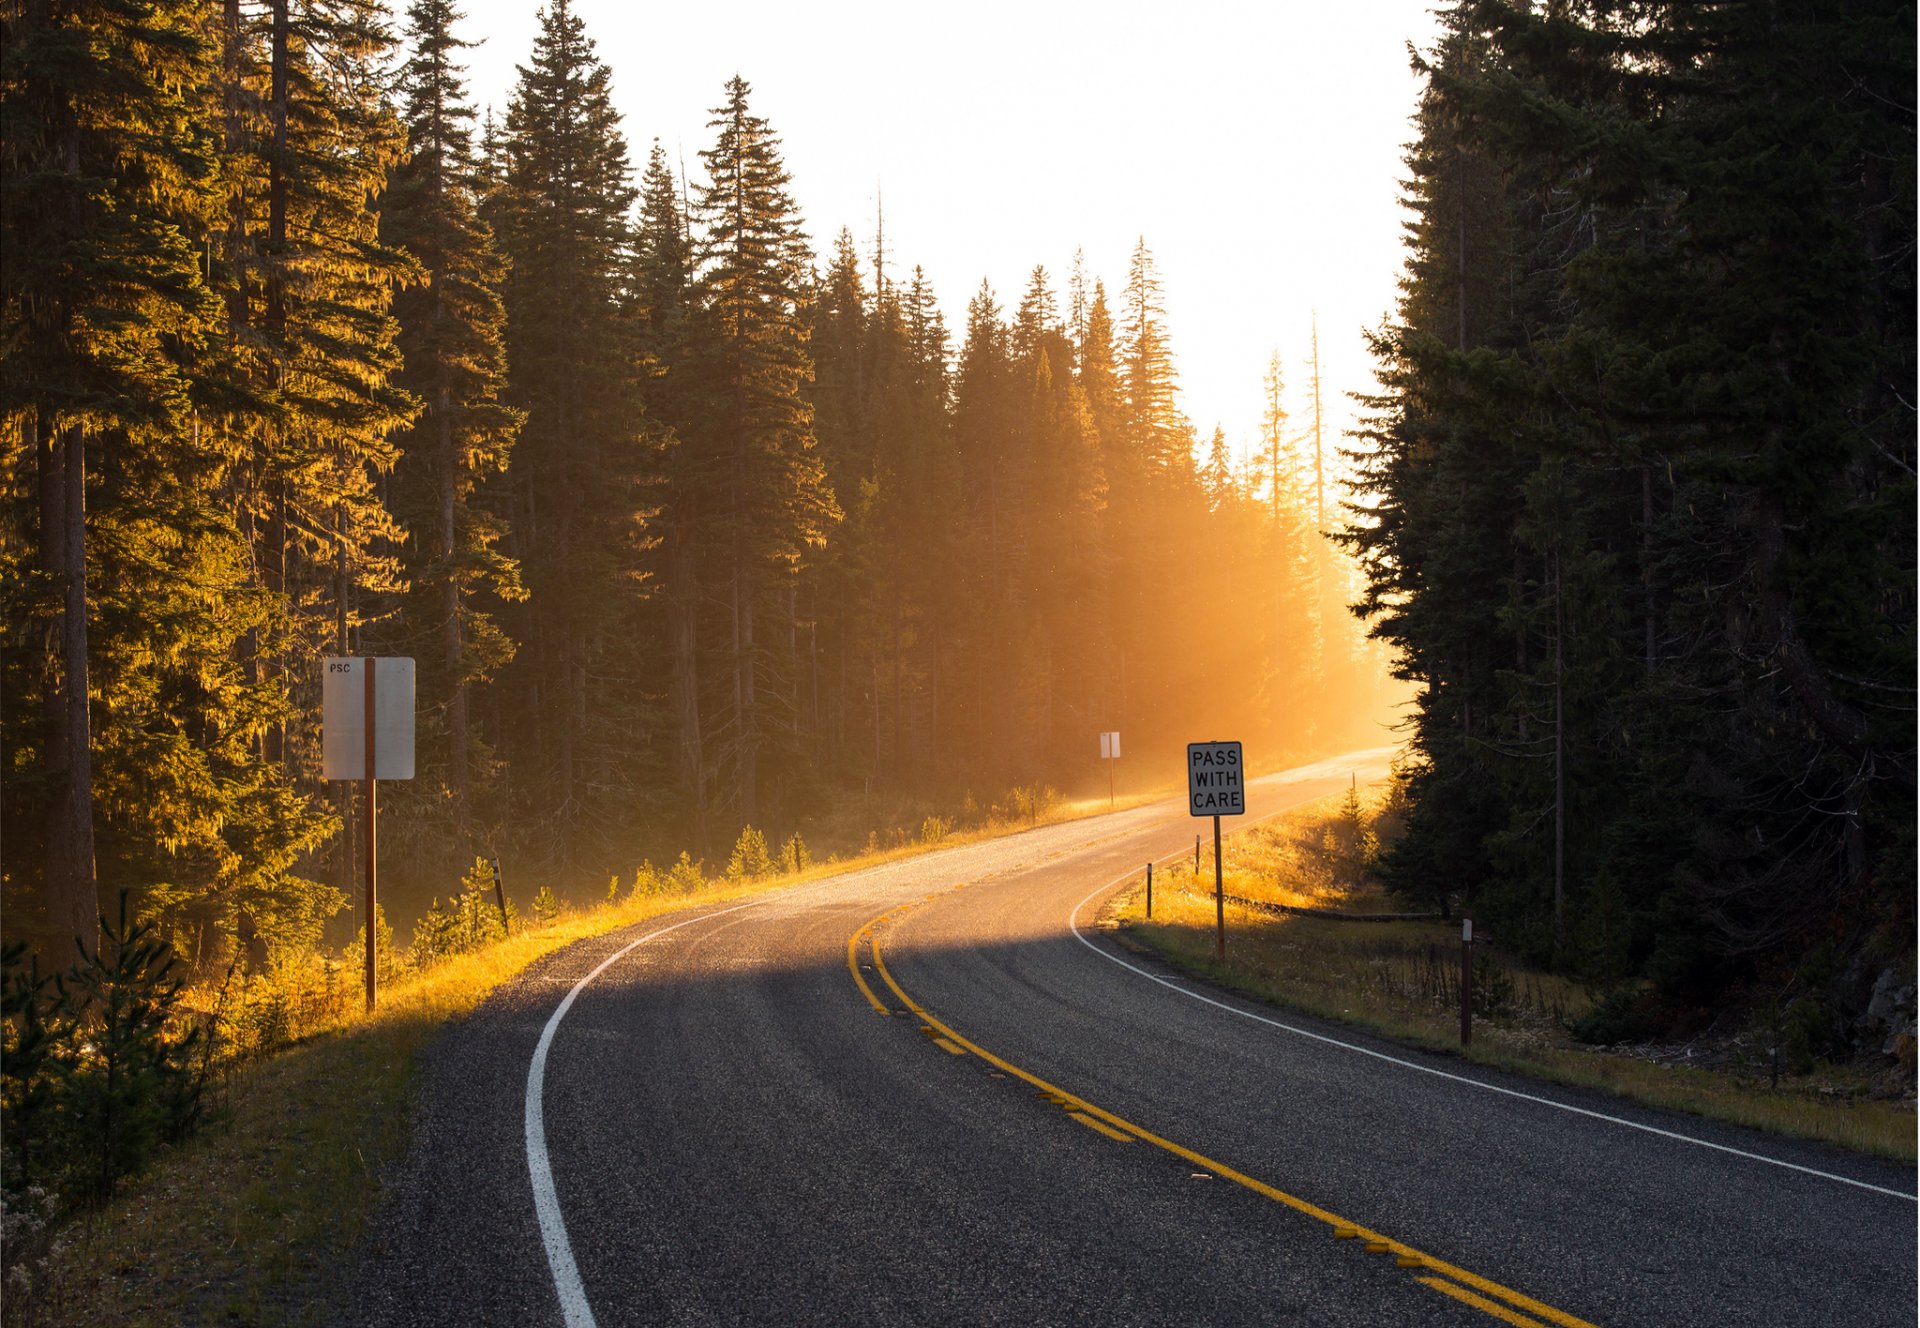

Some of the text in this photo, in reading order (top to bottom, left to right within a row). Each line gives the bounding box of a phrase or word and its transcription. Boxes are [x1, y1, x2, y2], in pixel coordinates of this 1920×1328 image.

[330, 663, 350, 673] PSC
[1193, 750, 1237, 766] PASS
[1195, 771, 1237, 787] WITH
[1193, 791, 1240, 808] CARE
